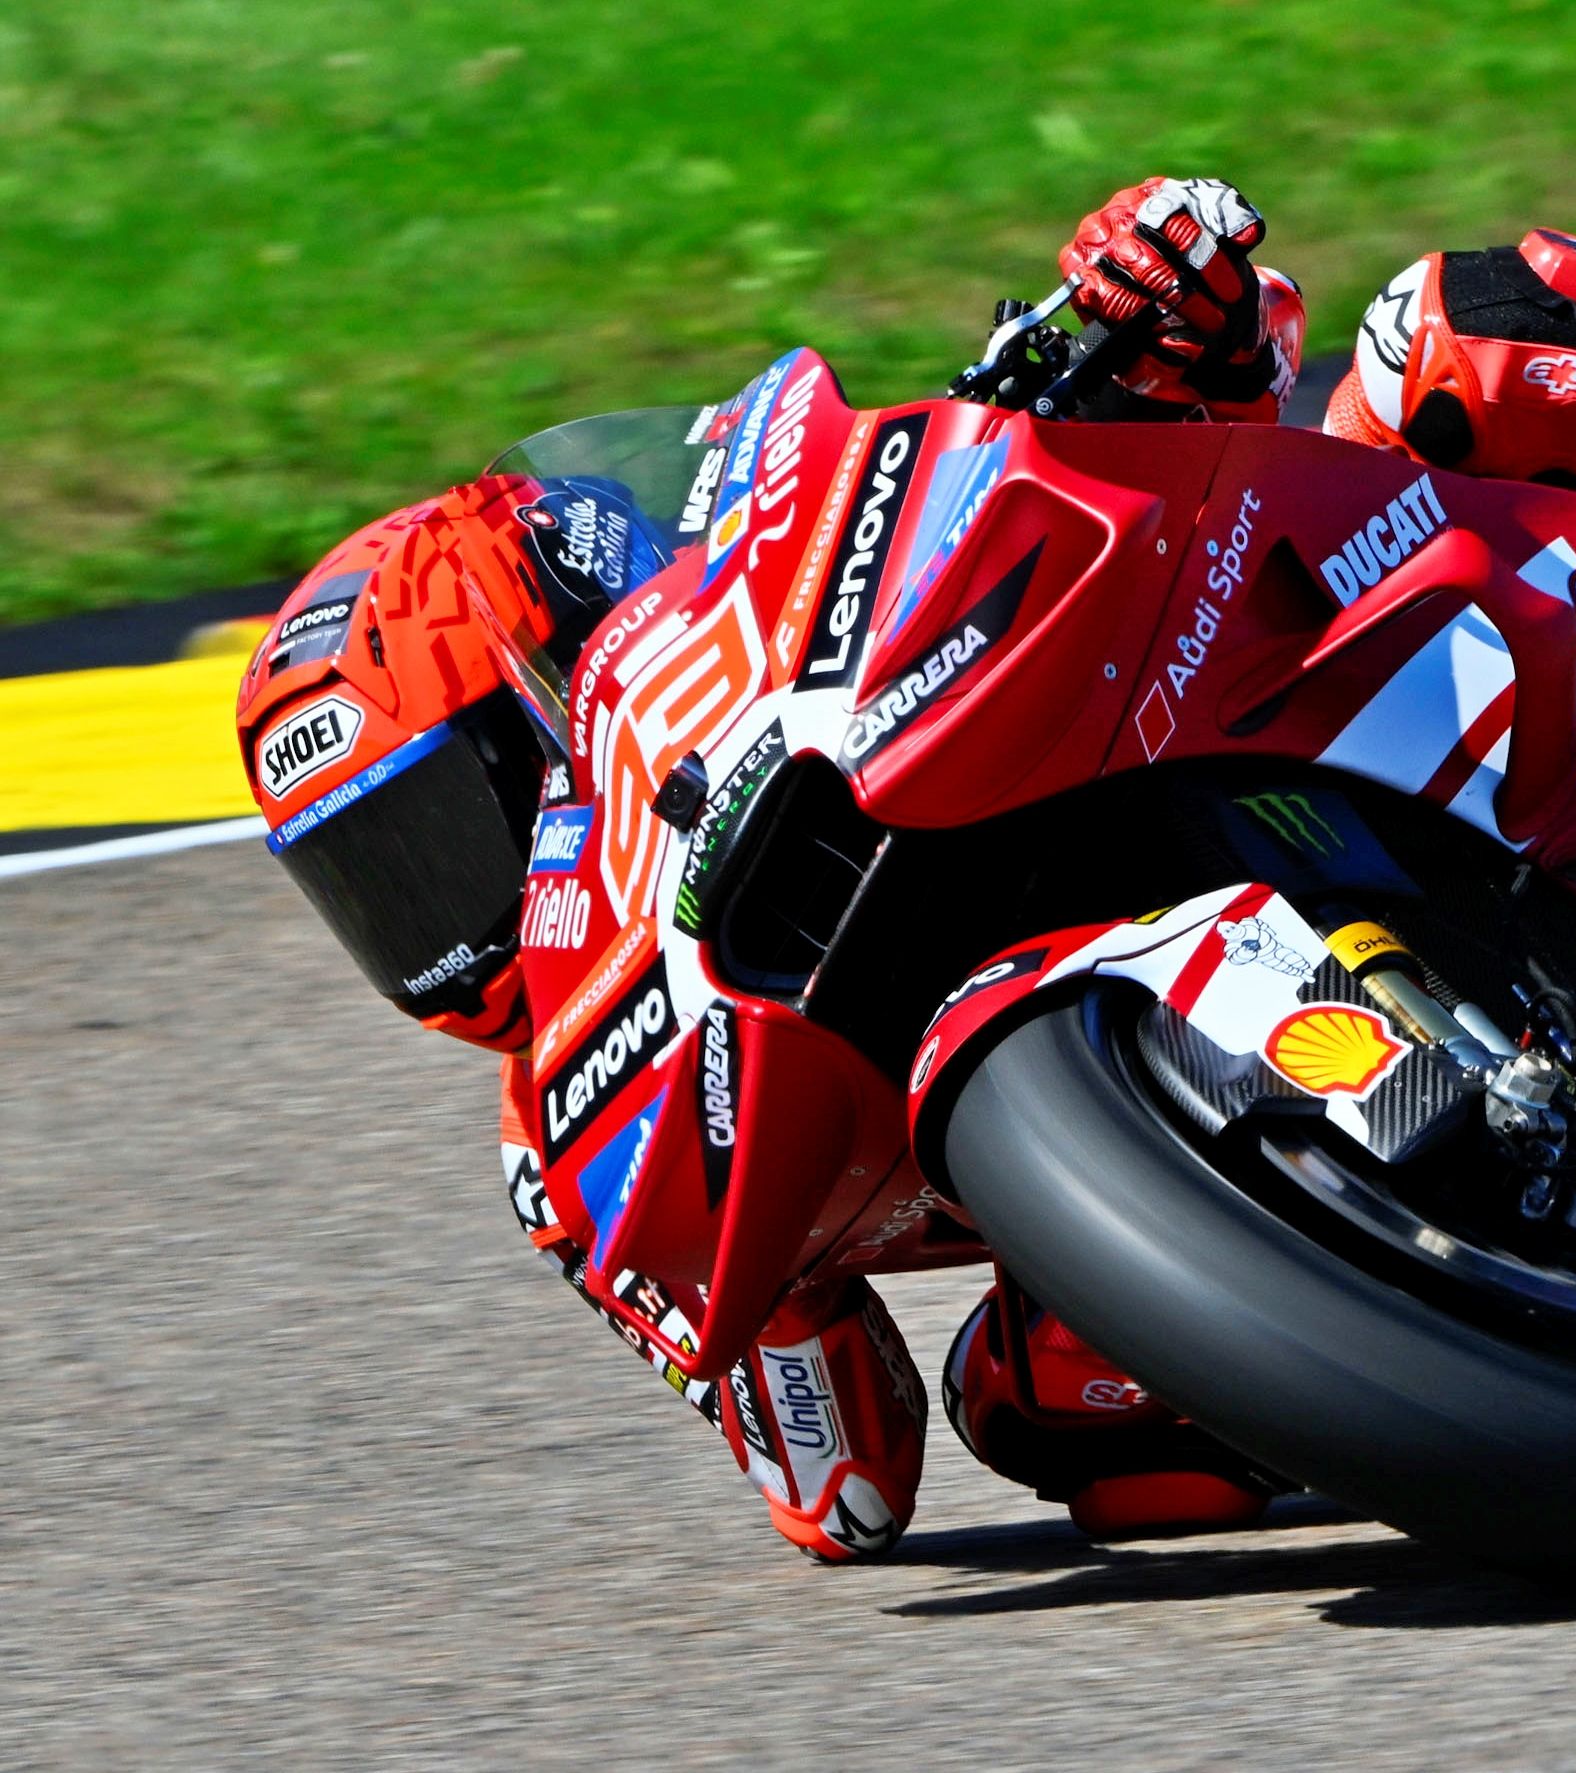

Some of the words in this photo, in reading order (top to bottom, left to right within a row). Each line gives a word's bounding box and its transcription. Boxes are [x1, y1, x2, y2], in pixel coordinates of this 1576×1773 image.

[728, 363, 790, 484] ADVANCE
[678, 447, 727, 533] WRS
[793, 422, 869, 612] FRECCIAROSSA
[1320, 472, 1448, 609] DUCATI
[808, 430, 911, 676] Lenovo
[1166, 597, 1222, 699] Audi
[1207, 488, 1262, 600] Sport
[280, 603, 349, 639] Lenovo
[265, 709, 344, 786] SHOEI
[845, 623, 989, 760] CARRERA
[315, 781, 363, 820] Galicia
[403, 942, 476, 996] Insta360
[562, 922, 647, 1033] FRECCIAROSSA
[547, 988, 666, 1142] Lenovo
[703, 1008, 736, 1147] CARRERA
[730, 1358, 768, 1451] Lenov
[764, 1349, 827, 1450] Unipol
